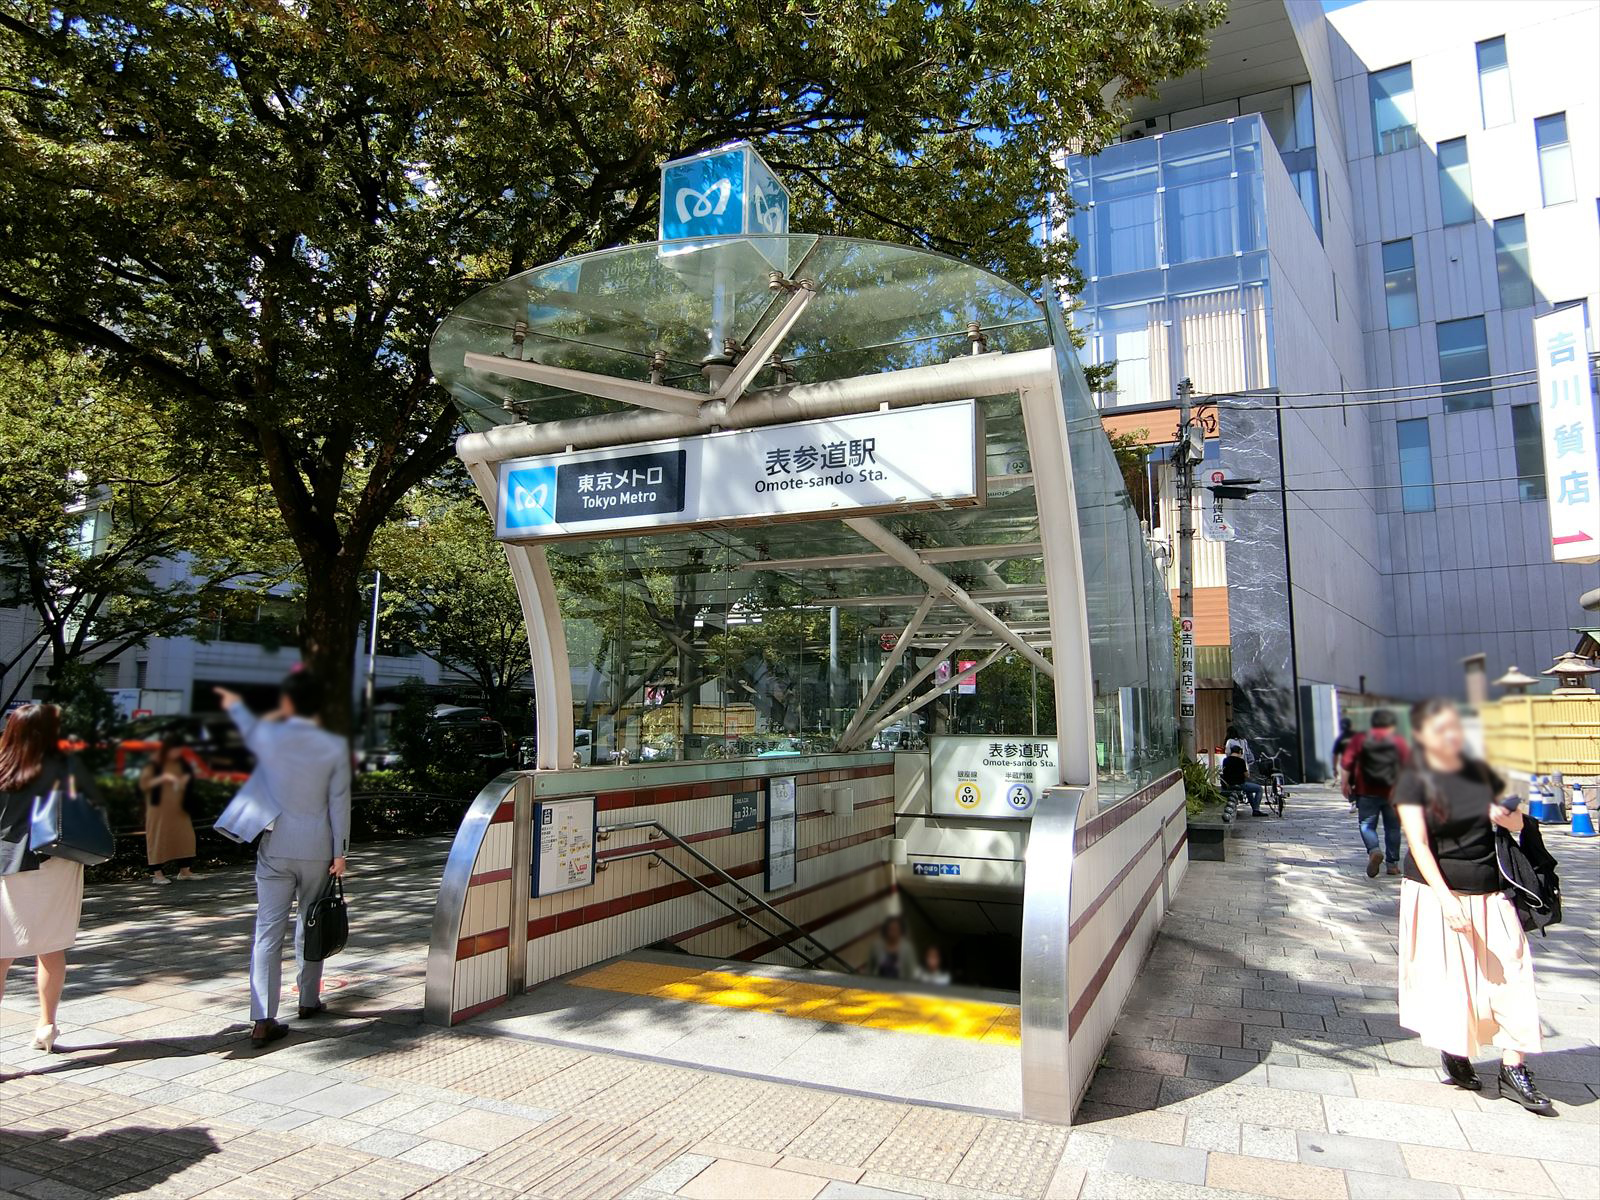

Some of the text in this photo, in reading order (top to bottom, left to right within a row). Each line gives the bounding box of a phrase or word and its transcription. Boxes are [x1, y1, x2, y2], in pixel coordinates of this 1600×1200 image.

[1547, 332, 1590, 505] 吉川質店
[766, 438, 876, 476] 表参道駅
[577, 466, 663, 493] 東京メトロ
[755, 469, 887, 493] Omote-sando Sta.
[582, 490, 657, 510] Tokyo Metro
[1181, 633, 1193, 687] 吉川質店
[989, 743, 1049, 758] 表参道駅
[982, 759, 1056, 768] Omote-sando Sta.
[962, 795, 974, 803] 02
[1013, 797, 1026, 805] 02
[1016, 788, 1022, 796] Z
